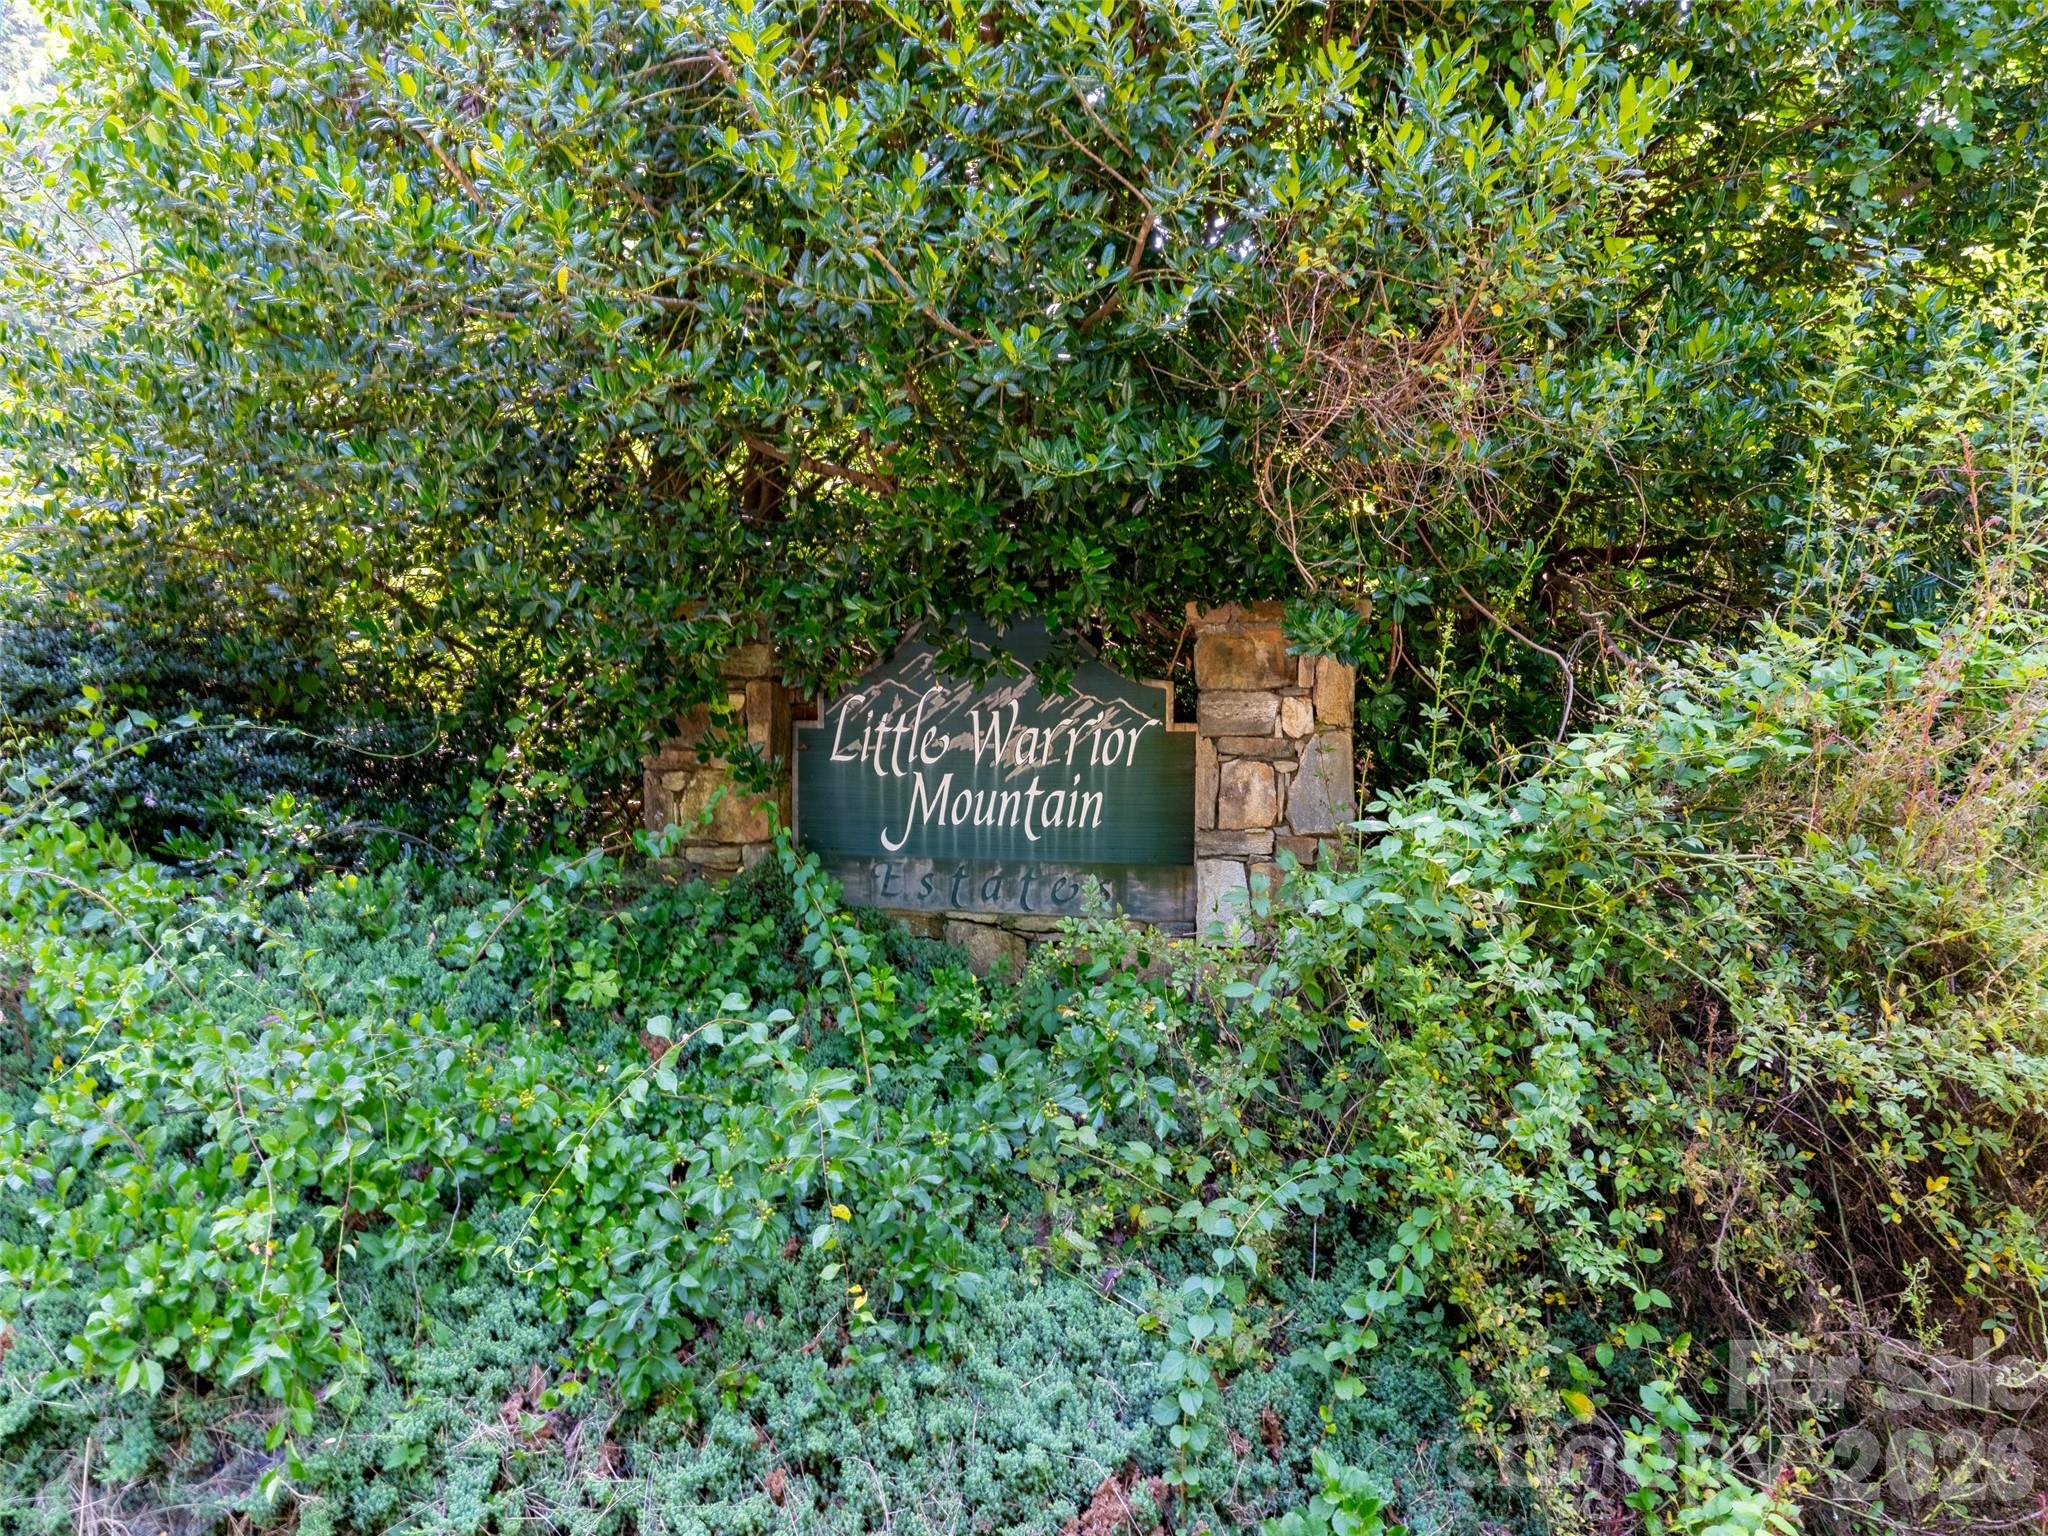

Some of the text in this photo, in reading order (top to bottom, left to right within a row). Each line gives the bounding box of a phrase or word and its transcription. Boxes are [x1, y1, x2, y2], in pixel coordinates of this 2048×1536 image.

[830, 685, 1163, 777] Little Warrior
[880, 771, 1104, 851] Mountain
[870, 862, 1113, 912] Estates
